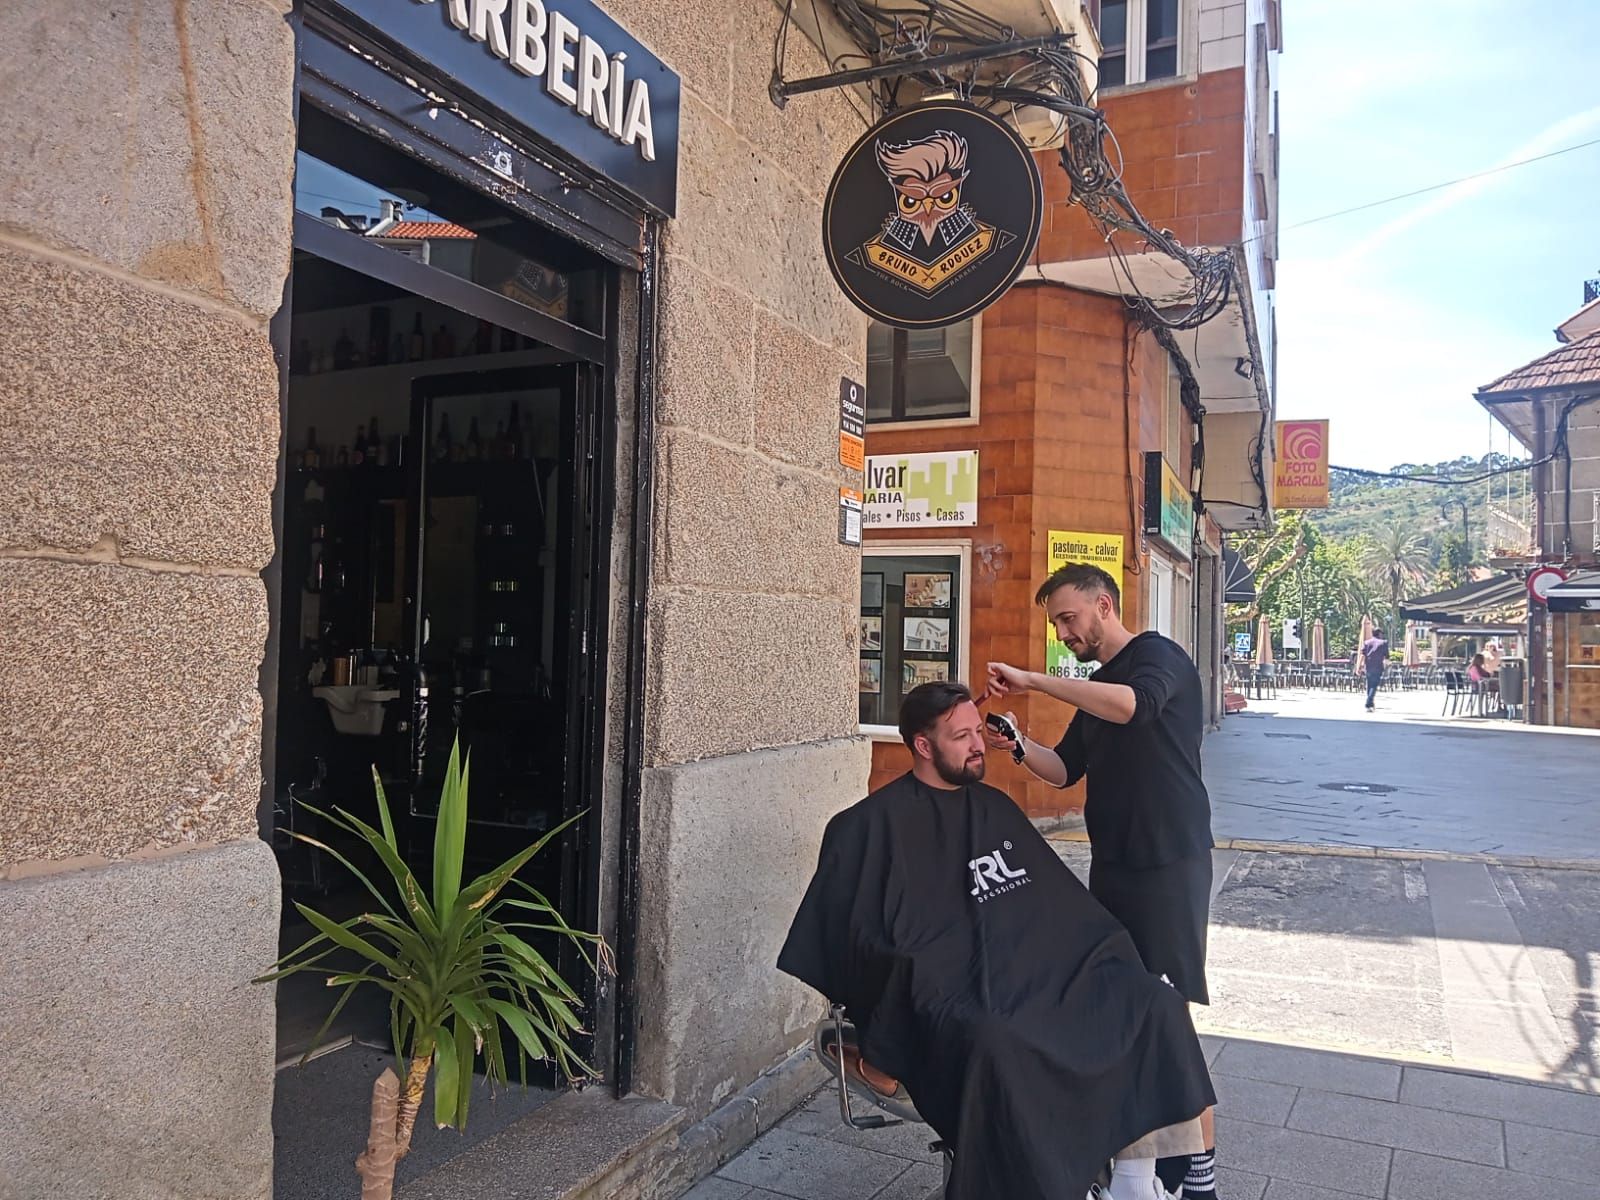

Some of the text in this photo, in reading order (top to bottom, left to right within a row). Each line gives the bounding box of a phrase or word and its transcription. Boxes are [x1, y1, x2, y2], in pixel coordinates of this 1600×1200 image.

[878, 251, 917, 277] BRUNO
[1285, 462, 1317, 473] FOTO
[1277, 475, 1325, 487] MARCIAL
[896, 509, 921, 522] Pisos
[936, 507, 965, 521] Casas
[1053, 541, 1088, 559] pastoriza
[1095, 542, 1119, 556] calvar
[1049, 666, 1070, 678] 986
